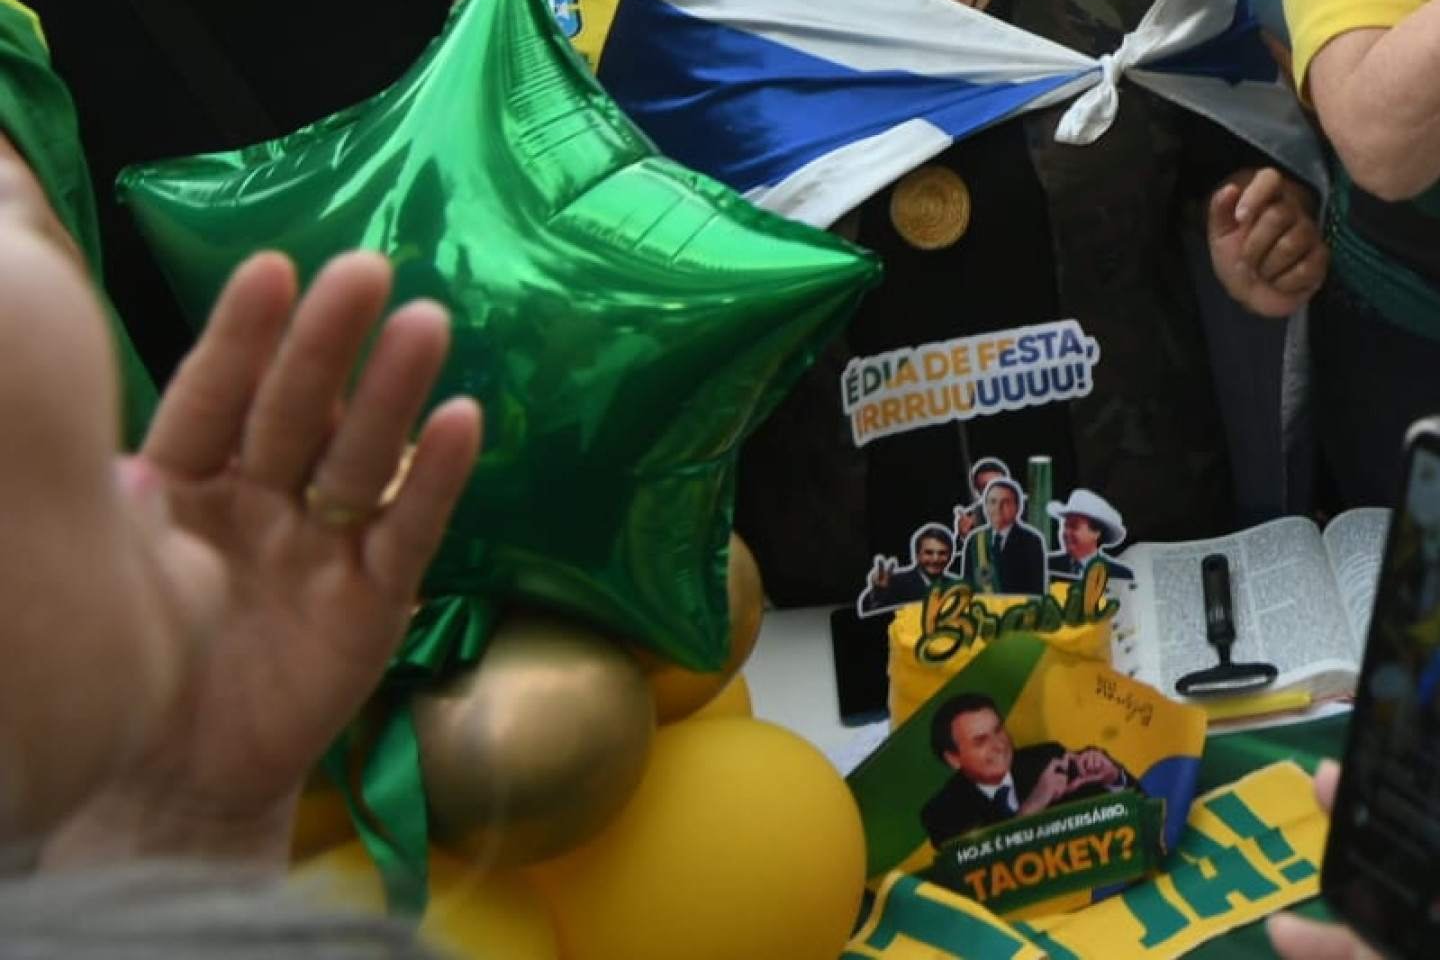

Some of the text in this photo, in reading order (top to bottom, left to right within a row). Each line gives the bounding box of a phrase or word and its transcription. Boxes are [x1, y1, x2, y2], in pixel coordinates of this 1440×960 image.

[922, 345, 971, 381] DE
[977, 327, 1094, 376] FESTA,
[957, 840, 992, 864] HOJE
[1006, 826, 1034, 849] MEU
[963, 825, 1136, 902] TAOKEY?
